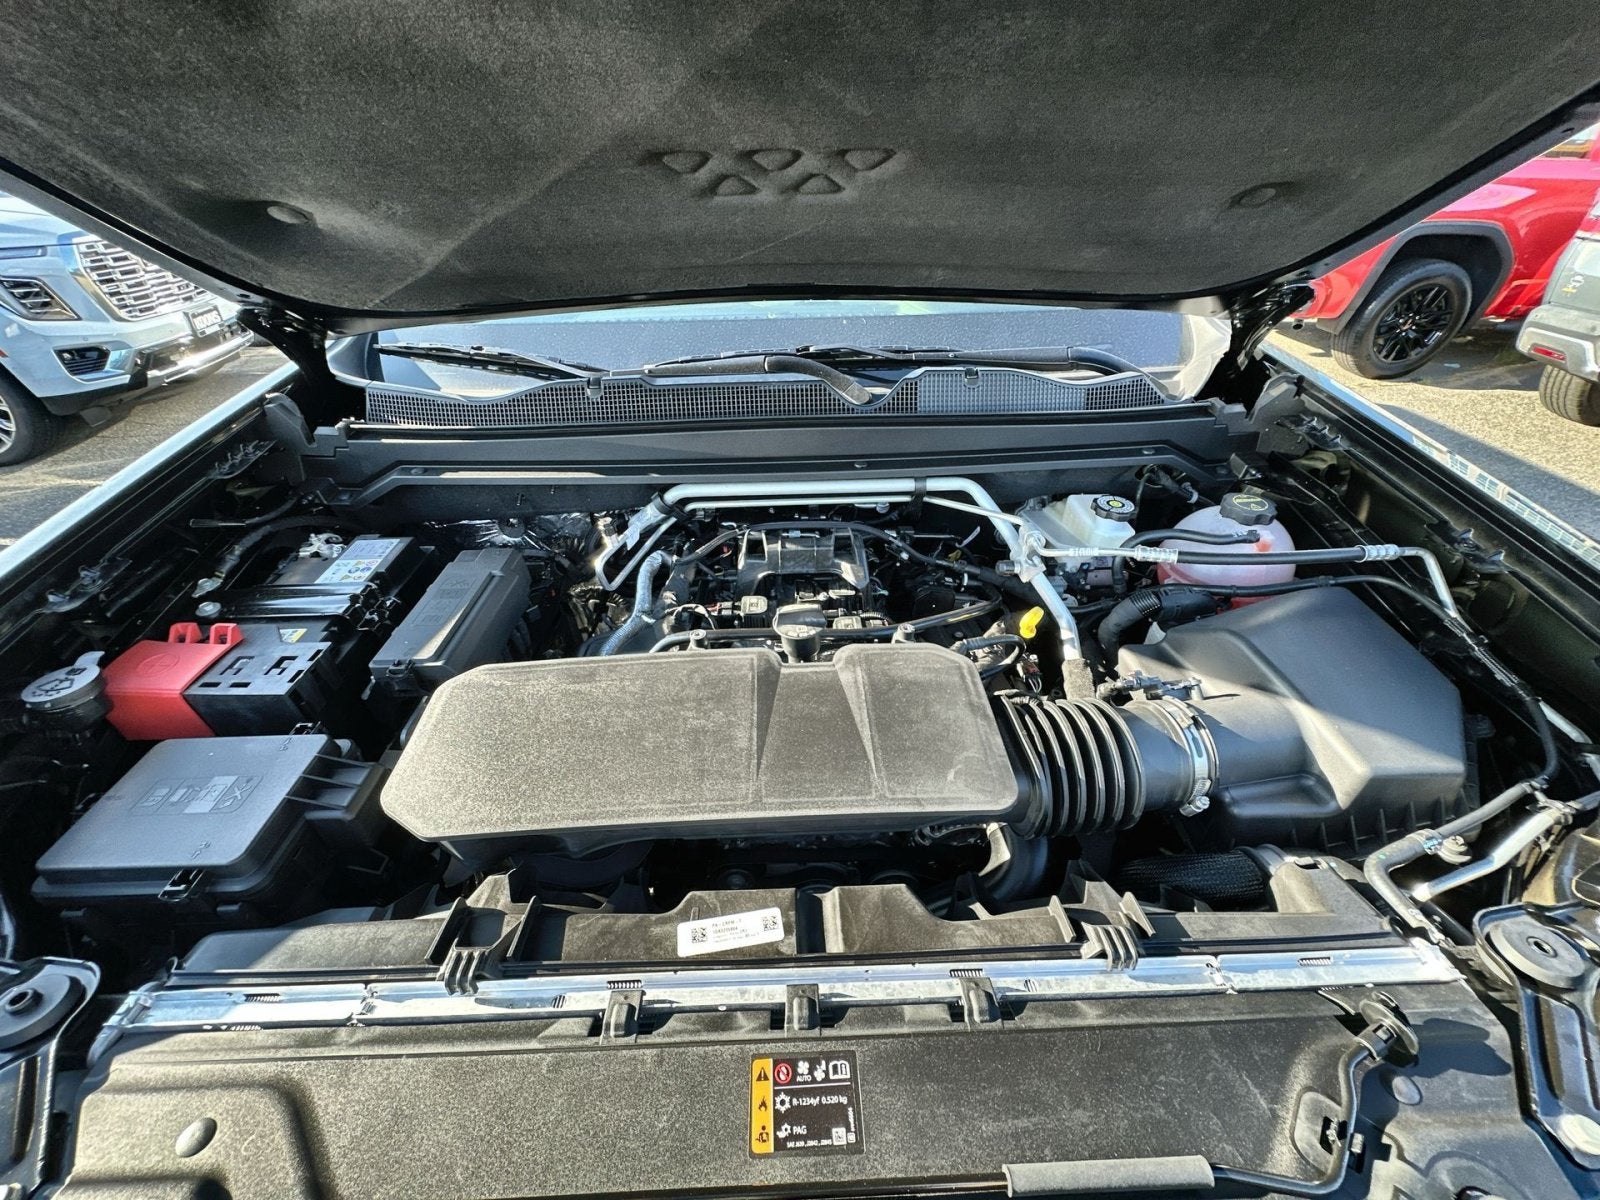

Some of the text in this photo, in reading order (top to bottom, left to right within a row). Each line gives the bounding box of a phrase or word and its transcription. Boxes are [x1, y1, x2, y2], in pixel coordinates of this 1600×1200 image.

[792, 1094, 848, 1107] R-1234yf 0.520 kg
[792, 1125, 808, 1135] PAG
